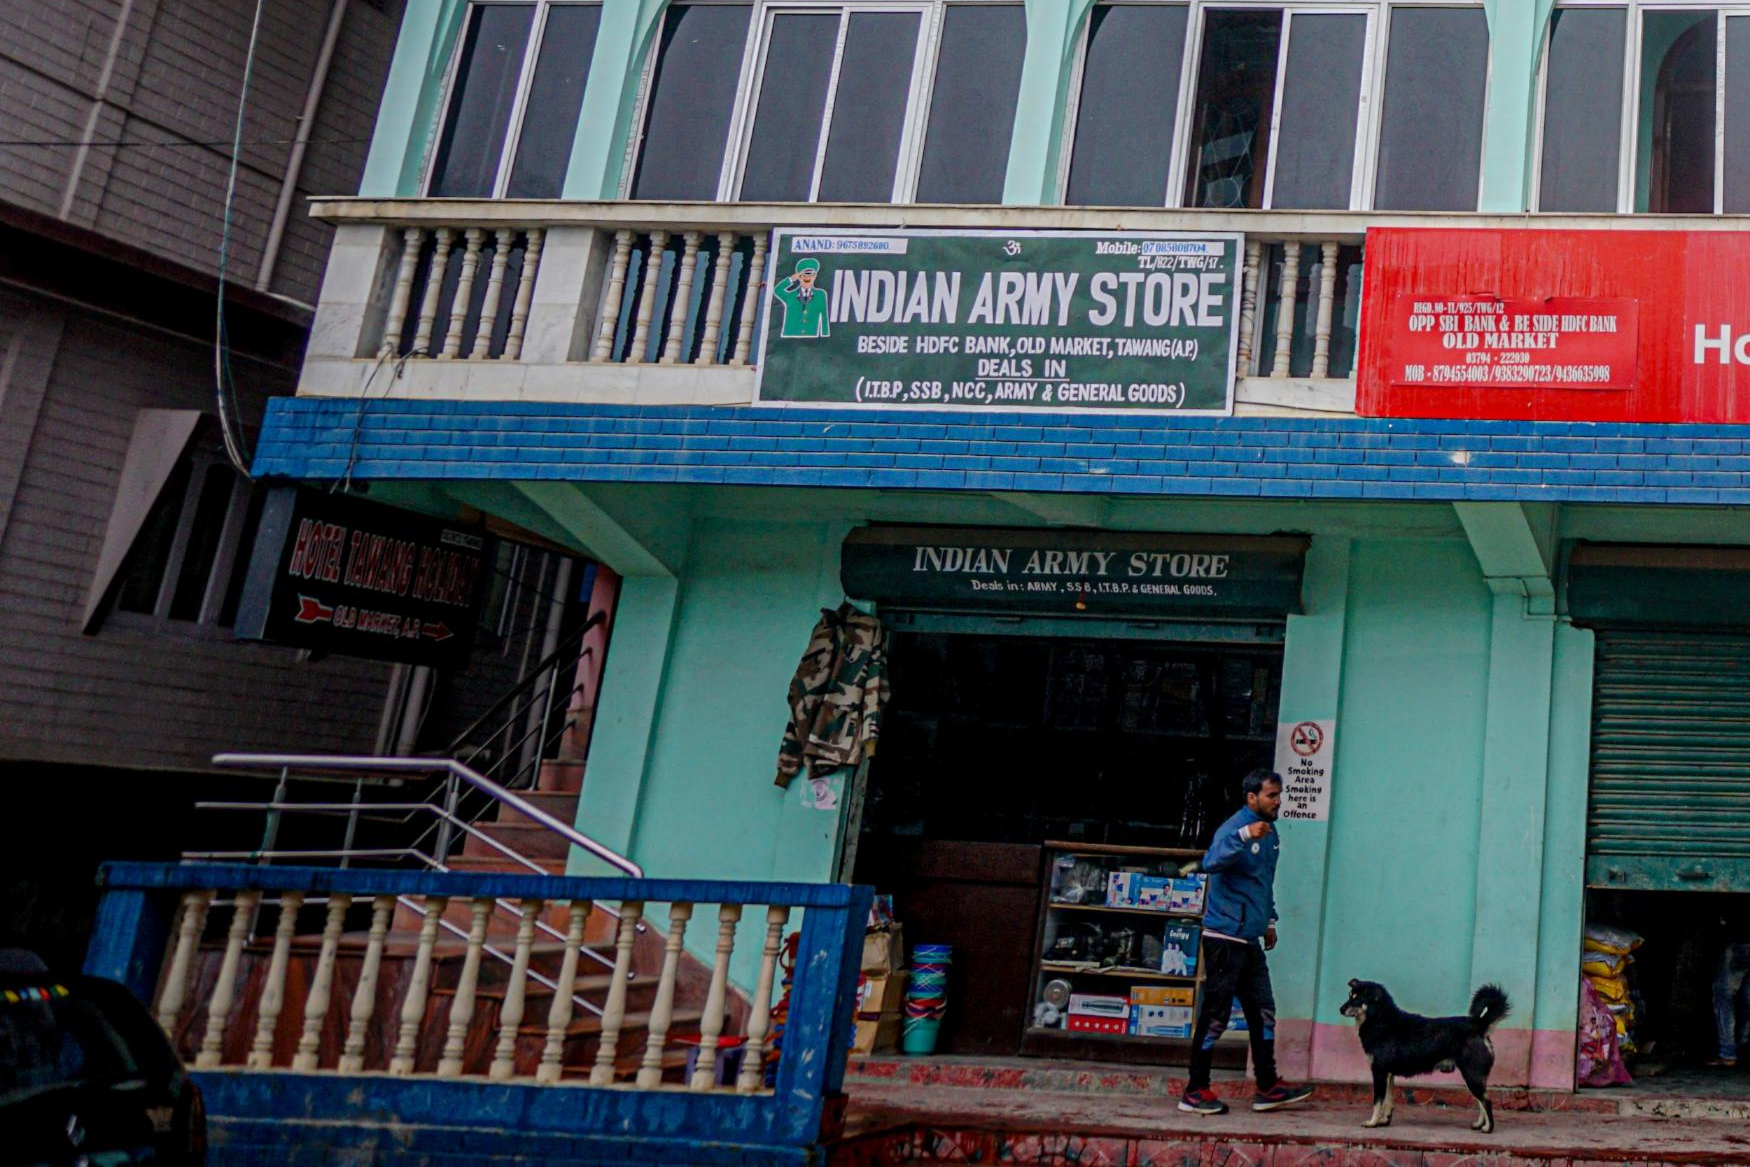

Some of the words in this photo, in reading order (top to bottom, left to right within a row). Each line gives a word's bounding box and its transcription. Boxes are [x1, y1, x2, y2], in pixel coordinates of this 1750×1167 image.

[793, 238, 836, 250] ANAND:
[1095, 241, 1142, 255] Mobile:
[830, 269, 961, 324] INDIAN
[967, 271, 1079, 327] ARMY
[1088, 272, 1226, 328] STORE
[1409, 314, 1435, 332] OPP
[1439, 314, 1459, 332] SBI
[1464, 314, 1497, 332] BANK
[1499, 315, 1510, 332] &
[1514, 315, 1530, 332] BE
[1532, 315, 1559, 332] SIDE
[1561, 315, 1588, 332] HDFC
[1589, 315, 1617, 333] BANK
[857, 336, 909, 354] BESIDE
[916, 336, 959, 354] HDFC
[1442, 332, 1480, 349] OLD
[1484, 332, 1560, 349] MARKET
[978, 359, 1032, 377] DEALS
[1044, 360, 1066, 377] IN
[1404, 364, 1425, 382] MOB
[994, 382, 1038, 400] ARMY
[1042, 383, 1053, 401] &
[1058, 383, 1125, 401] GENERAL
[288, 517, 348, 583] HOTEL
[343, 529, 417, 597] TAWANG
[912, 546, 1013, 574] INDIAN
[1021, 549, 1117, 575] ARMY
[1128, 551, 1229, 578] STORE
[970, 579, 1004, 591] Deals
[1132, 584, 1138, 594] &
[1140, 584, 1181, 595] GENERAL
[1301, 758, 1313, 767] No
[1288, 767, 1324, 776] Smoking
[1294, 776, 1315, 784] Area
[1285, 786, 1322, 794] Smoking
[1288, 794, 1307, 802] here
[1310, 794, 1316, 802] is
[1297, 802, 1307, 810] an
[1283, 810, 1317, 819] Offence
